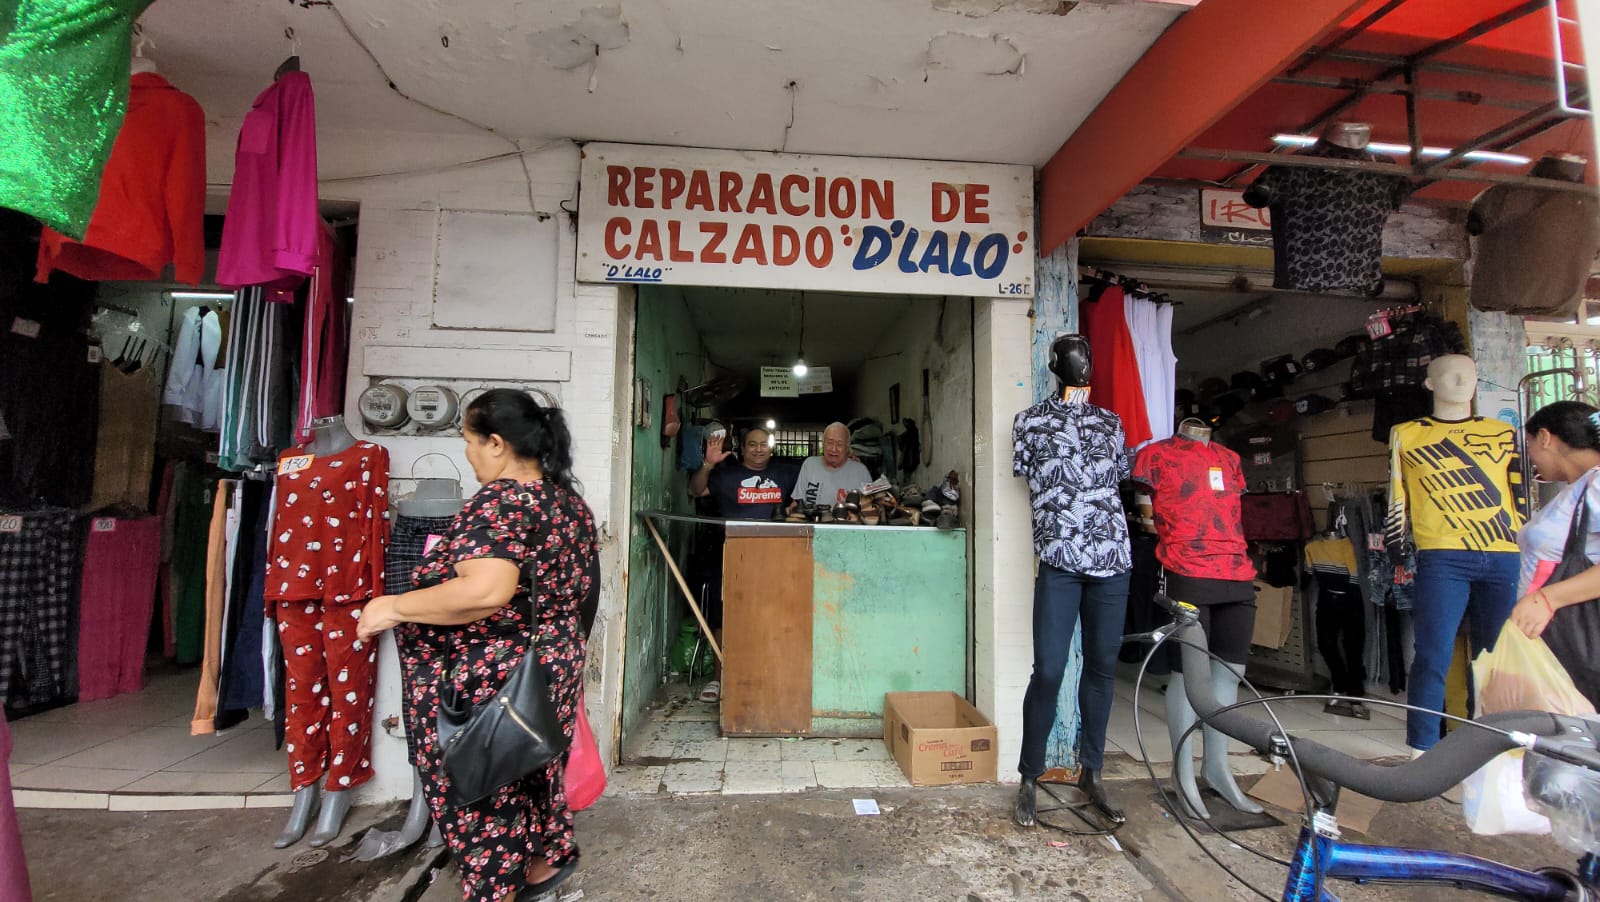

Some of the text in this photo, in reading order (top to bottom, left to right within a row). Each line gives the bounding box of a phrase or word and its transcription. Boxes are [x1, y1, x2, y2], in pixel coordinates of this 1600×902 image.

[606, 165, 991, 224] REPARACION DE
[604, 216, 834, 269] CALZADO
[740, 488, 782, 503] Supreme
